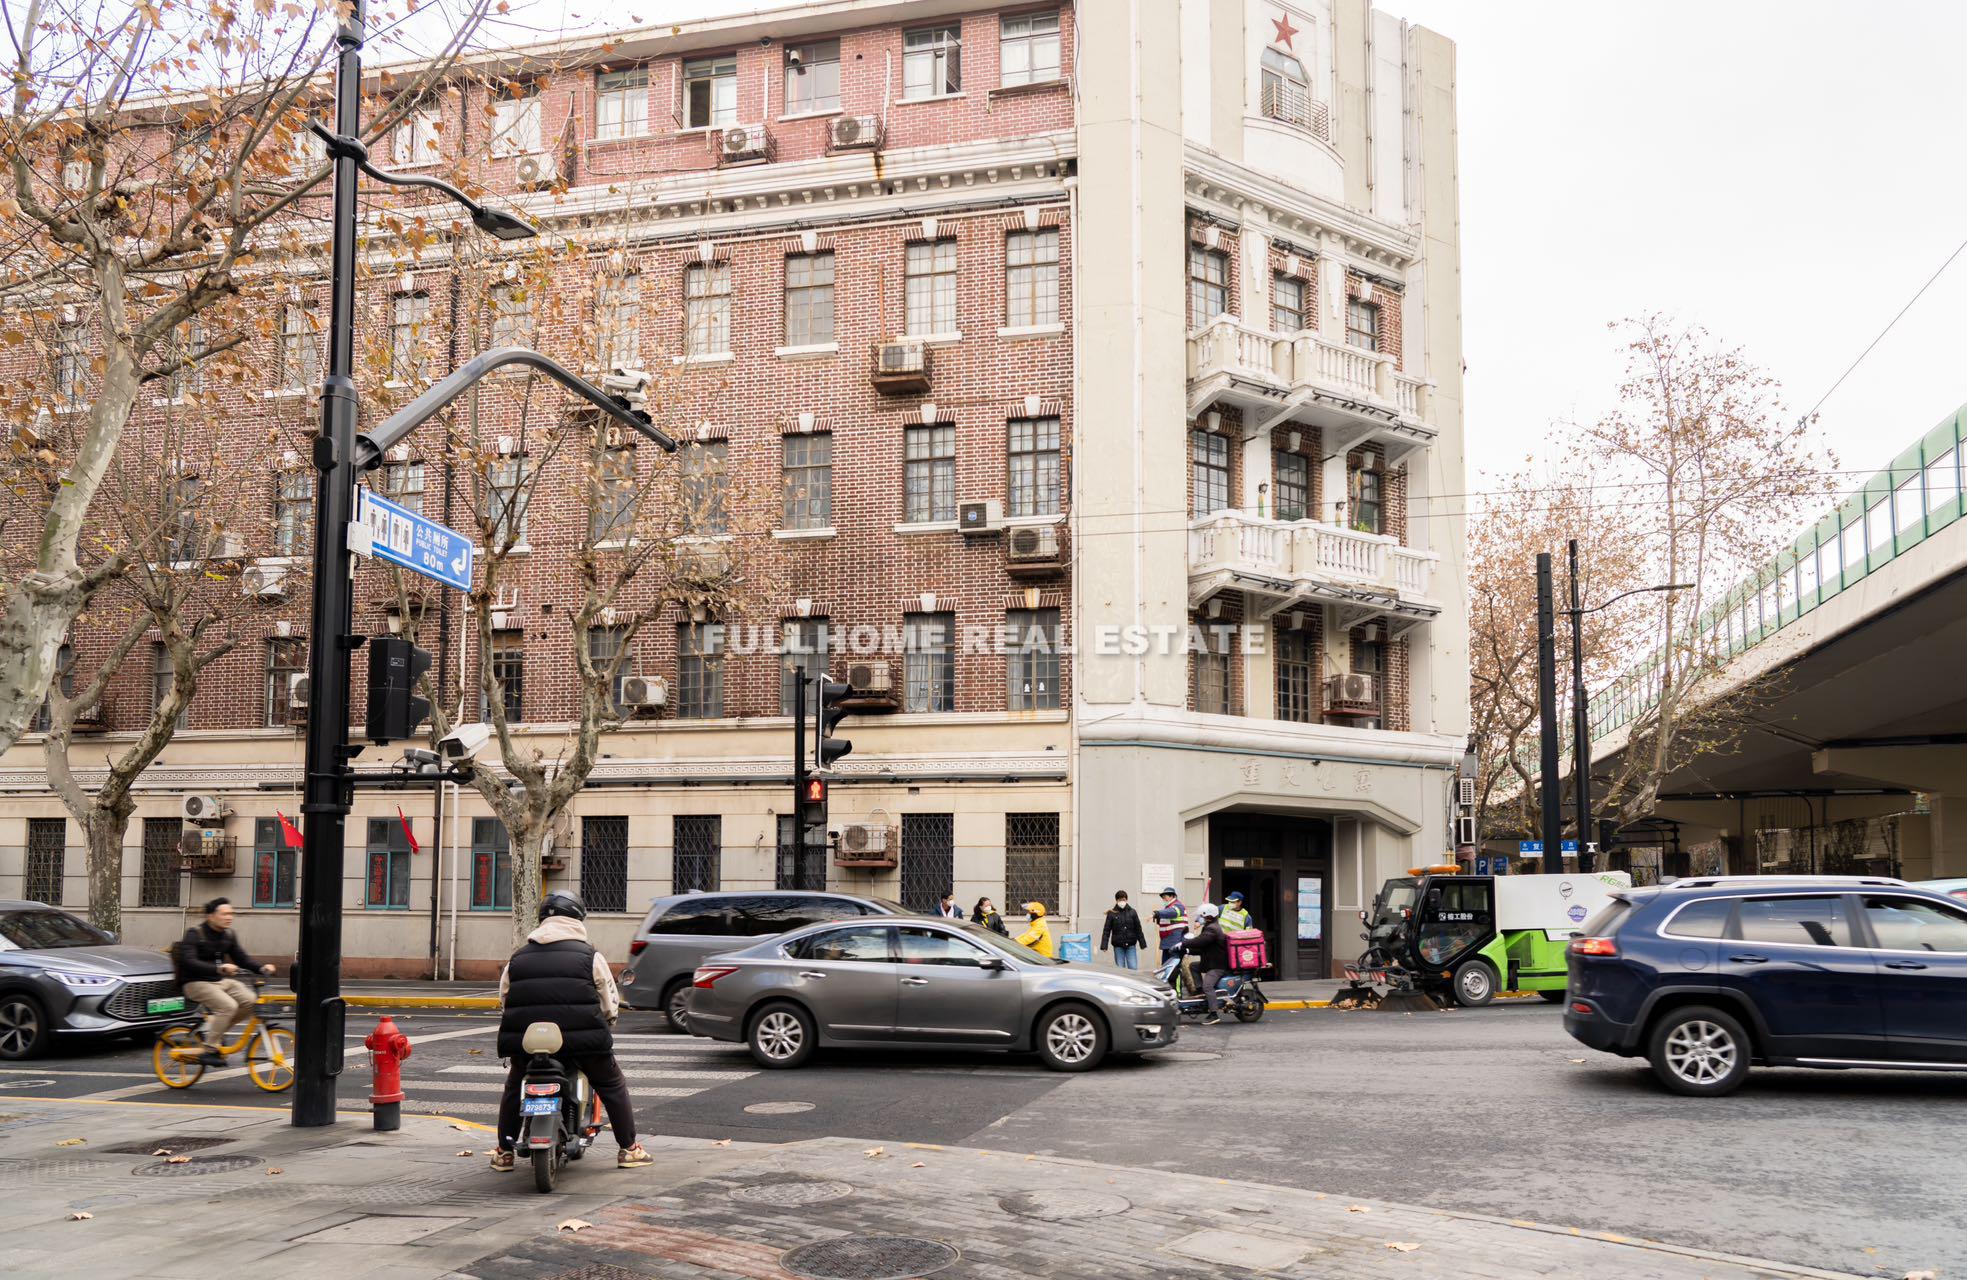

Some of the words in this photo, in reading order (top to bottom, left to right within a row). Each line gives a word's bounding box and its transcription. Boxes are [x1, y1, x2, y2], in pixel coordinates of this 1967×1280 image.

[415, 538, 432, 551] PUBLIC
[434, 546, 448, 558] TOILET
[423, 551, 444, 572] 80m
[1478, 860, 1486, 871] P
